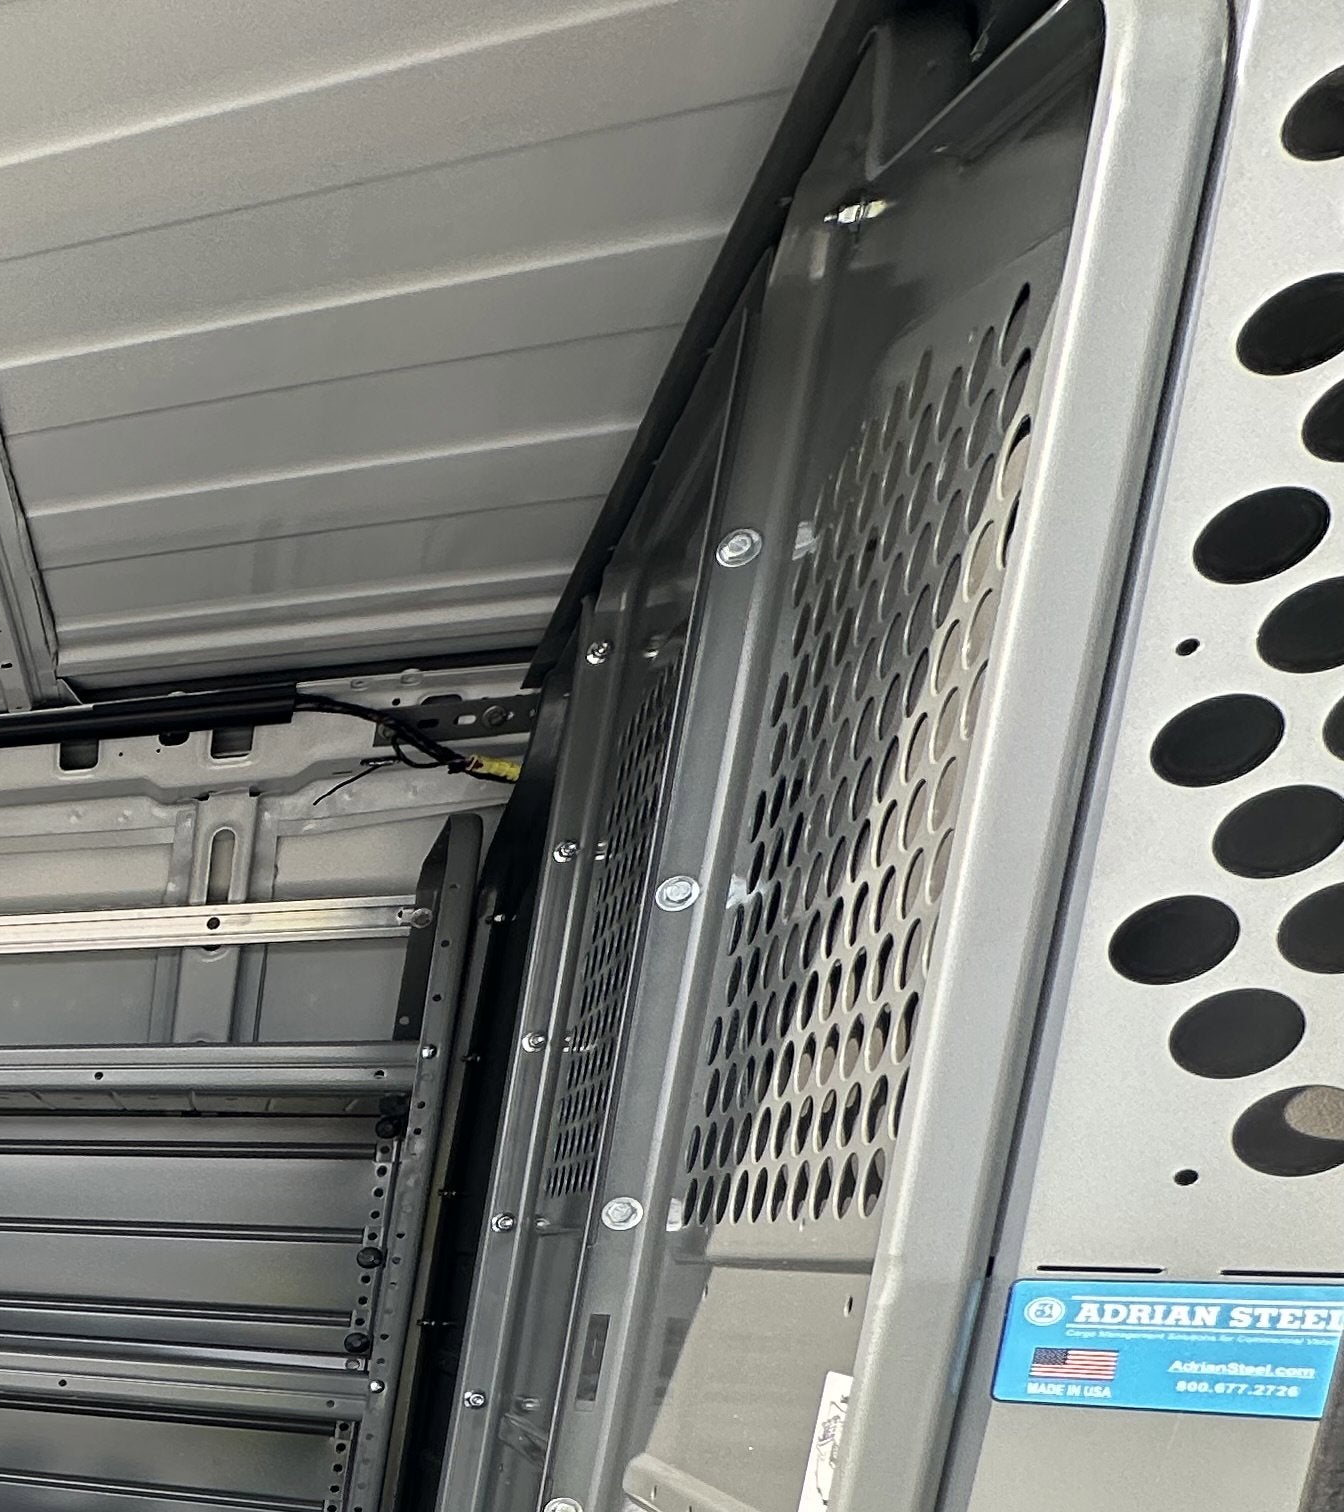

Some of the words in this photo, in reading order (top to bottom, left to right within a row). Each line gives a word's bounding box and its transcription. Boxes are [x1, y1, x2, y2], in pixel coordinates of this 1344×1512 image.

[1074, 1302, 1220, 1326] ADRIAN
[1167, 1360, 1316, 1379] AdrianSteel.com
[1027, 1381, 1065, 1396] MADE
[1066, 1384, 1081, 1397] IN
[1083, 1385, 1112, 1399] USA
[1175, 1380, 1300, 1398] 800.677.2726
